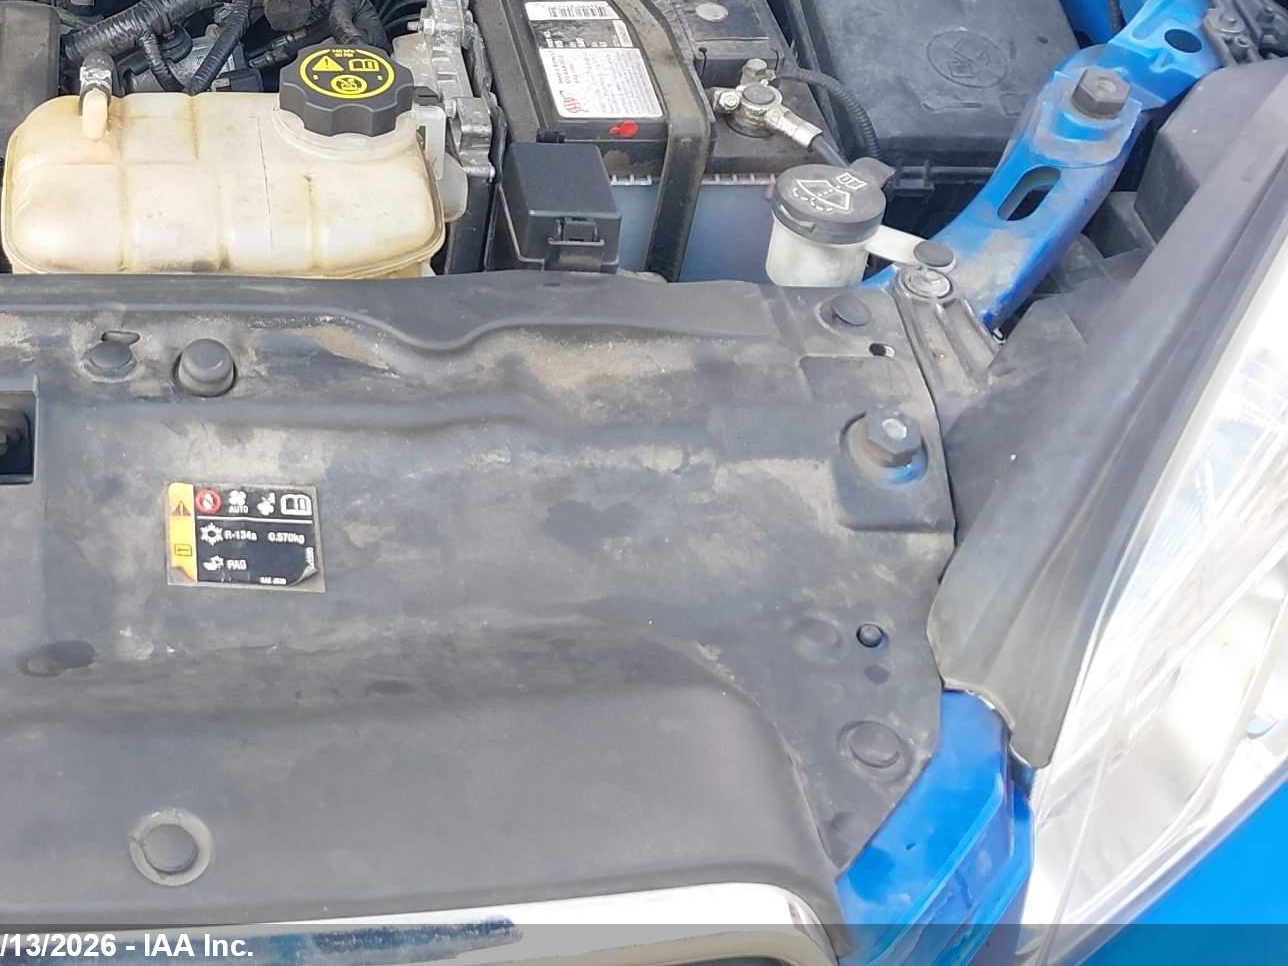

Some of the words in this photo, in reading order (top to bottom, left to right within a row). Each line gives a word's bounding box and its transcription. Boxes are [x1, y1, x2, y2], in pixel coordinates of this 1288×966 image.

[228, 505, 249, 514] AUTO
[224, 530, 257, 541] R-134a
[226, 559, 247, 570] PAG
